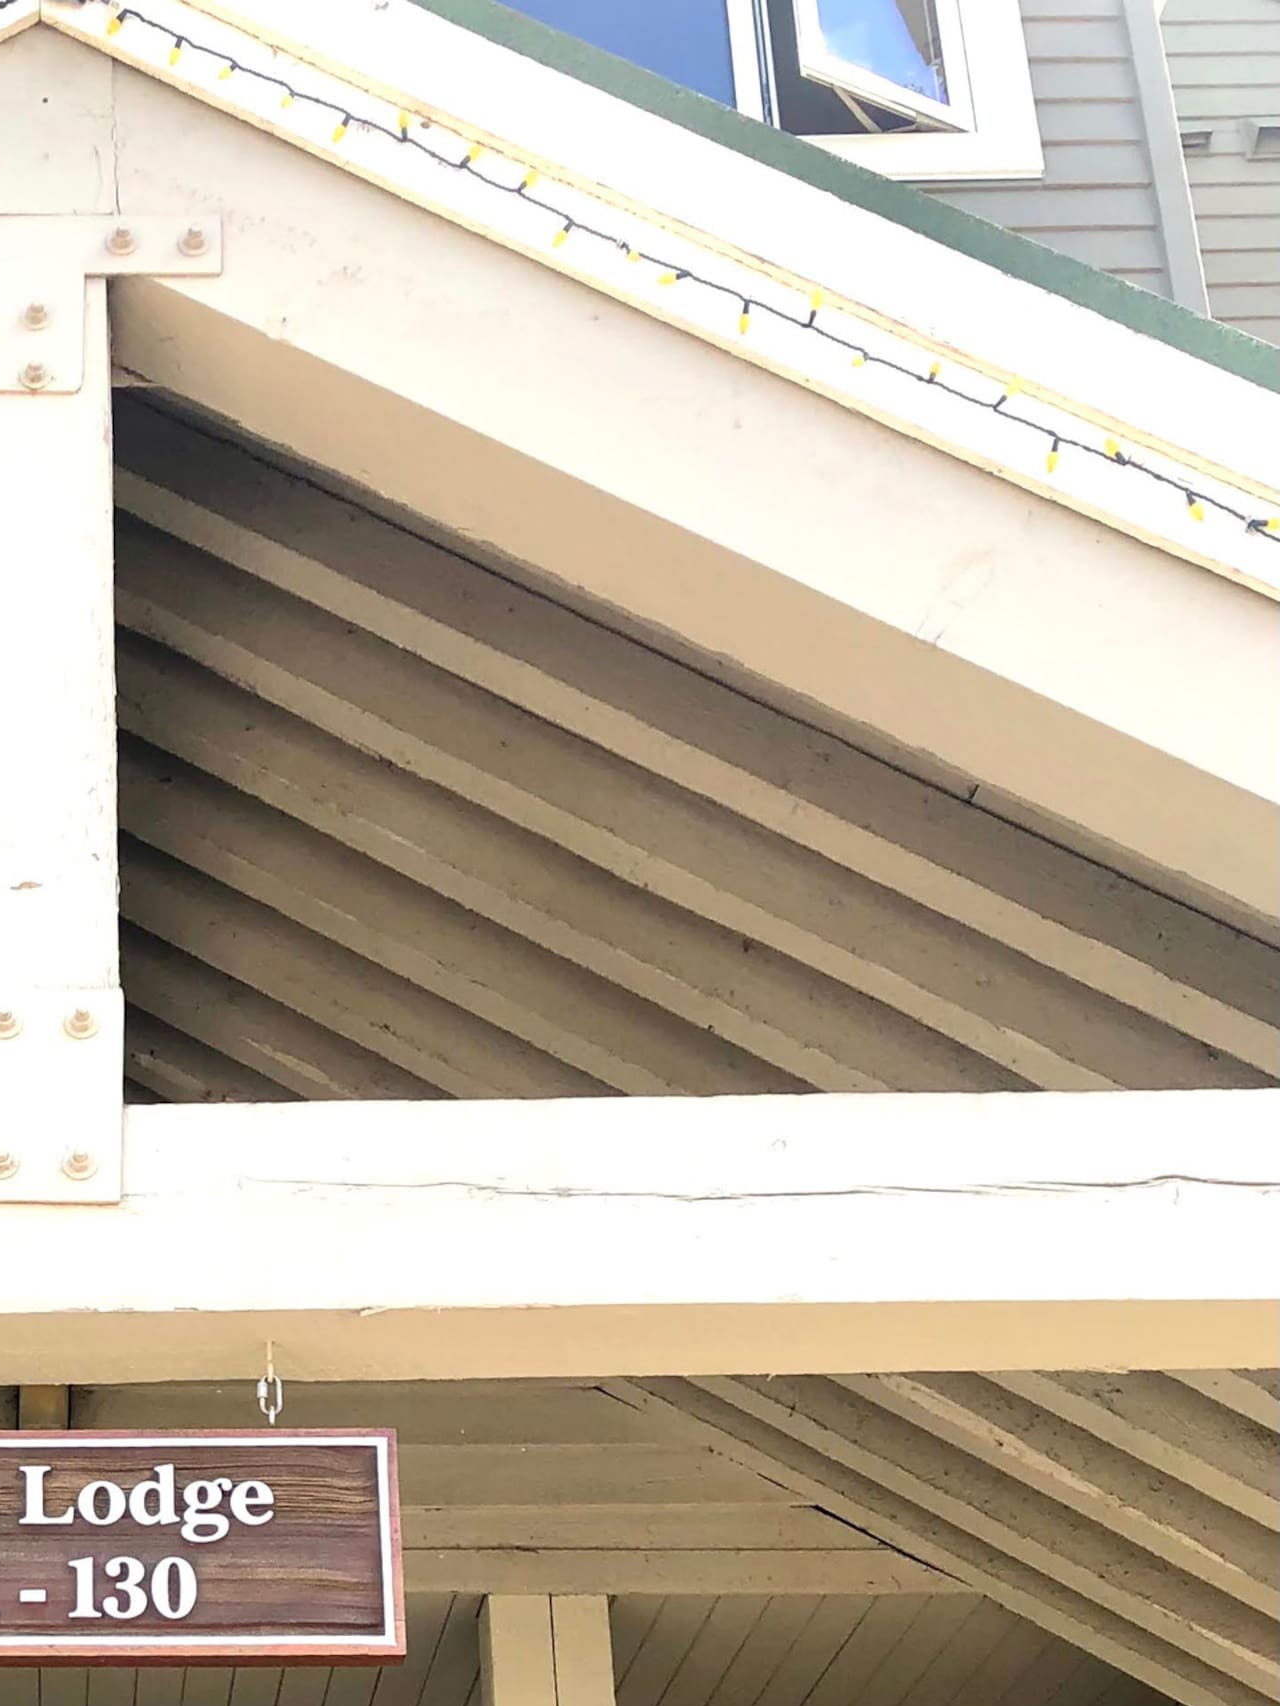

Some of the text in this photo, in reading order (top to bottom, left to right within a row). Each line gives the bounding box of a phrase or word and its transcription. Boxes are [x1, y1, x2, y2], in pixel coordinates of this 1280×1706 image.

[18, 1462, 275, 1544] Lodge
[20, 1588, 46, 1603] -
[67, 1555, 198, 1620] 130
